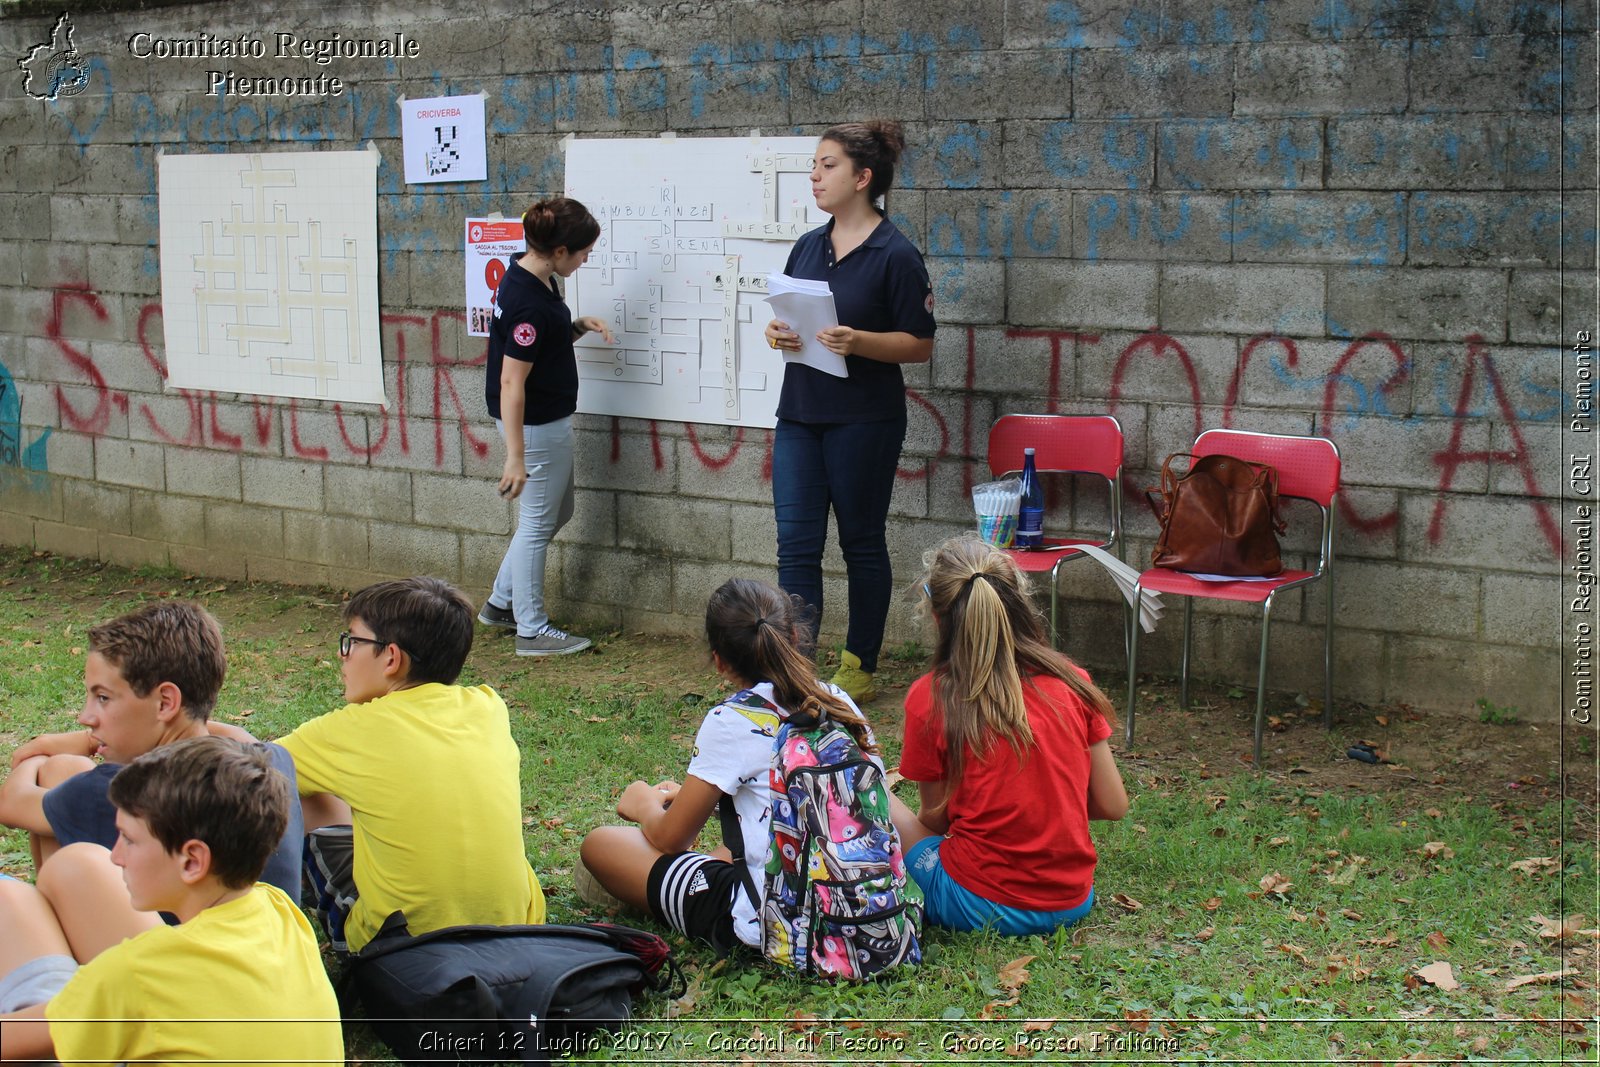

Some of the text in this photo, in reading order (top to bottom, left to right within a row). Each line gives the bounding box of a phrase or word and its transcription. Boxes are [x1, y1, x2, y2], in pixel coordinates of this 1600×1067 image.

[416, 107, 462, 120] CRICIVERBA
[651, 238, 721, 251] SIRENA
[688, 869, 703, 896] adidas
